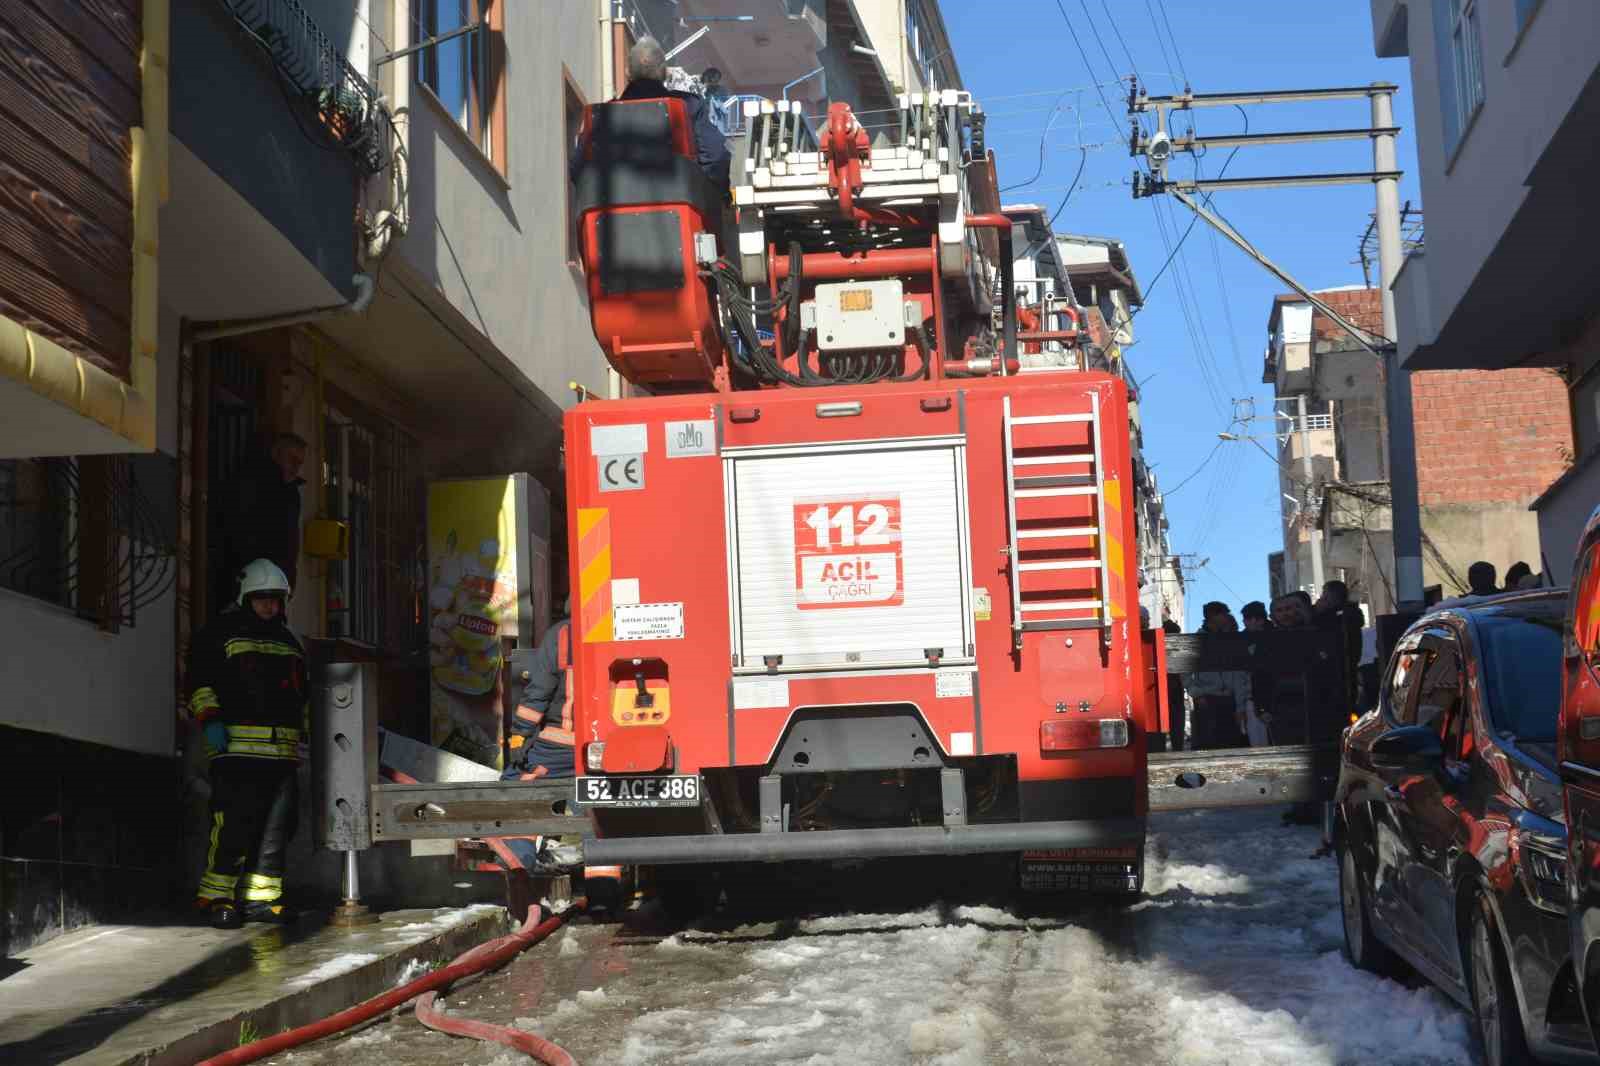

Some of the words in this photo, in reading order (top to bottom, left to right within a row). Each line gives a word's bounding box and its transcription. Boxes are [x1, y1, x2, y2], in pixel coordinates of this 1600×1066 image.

[678, 423, 703, 448] DMO
[604, 457, 638, 485] CE
[806, 504, 890, 548] 112
[820, 557, 879, 582] ACİL
[460, 615, 495, 635] Lipton
[587, 779, 612, 800] 52
[618, 780, 655, 799] ACF
[659, 778, 696, 799] 386
